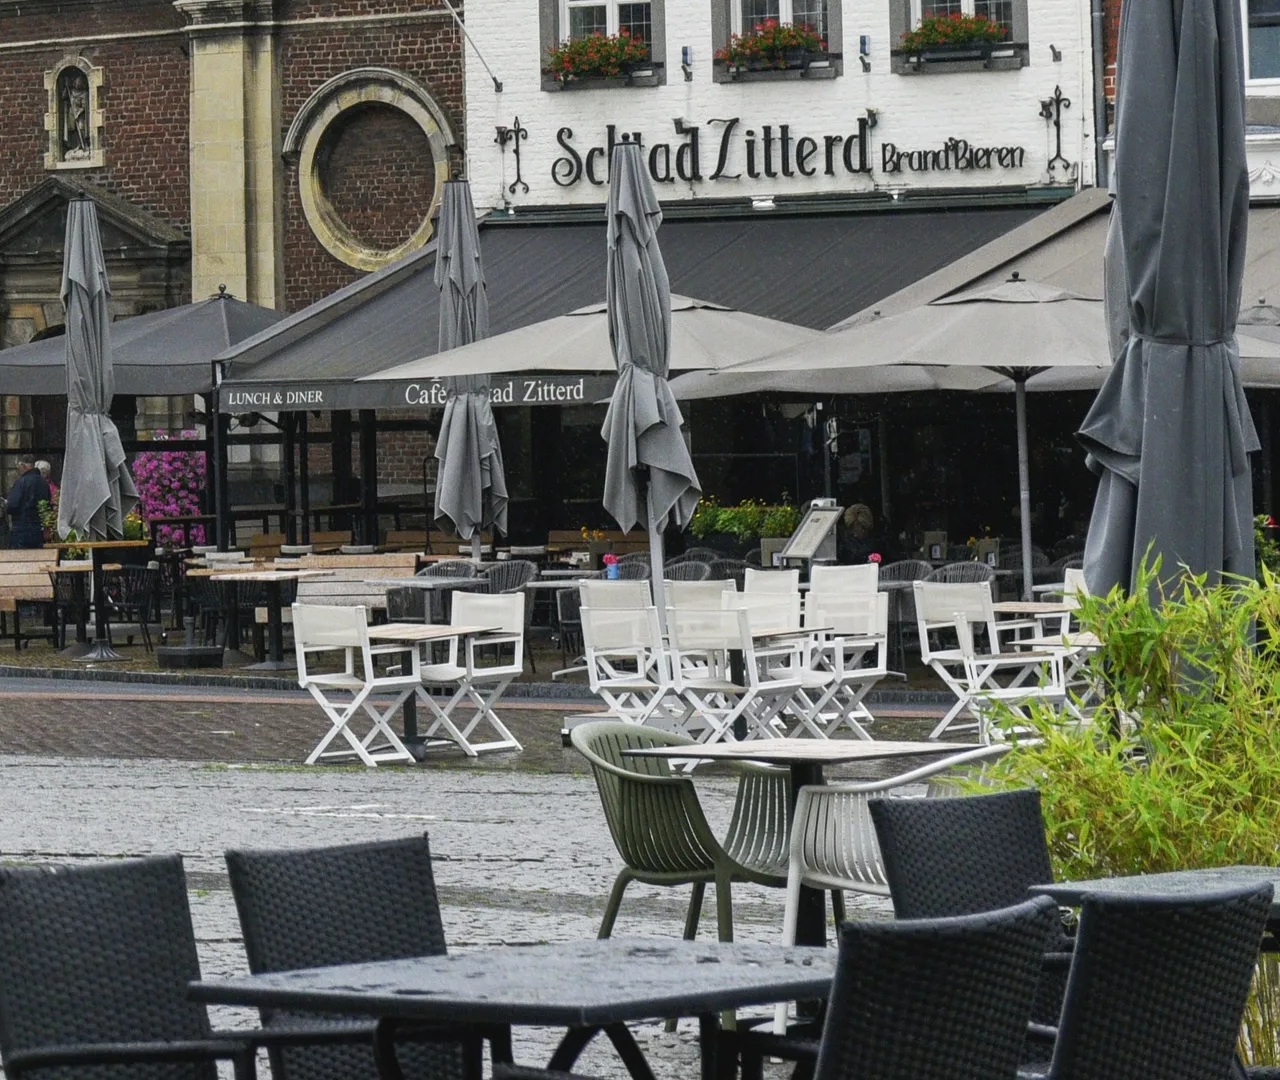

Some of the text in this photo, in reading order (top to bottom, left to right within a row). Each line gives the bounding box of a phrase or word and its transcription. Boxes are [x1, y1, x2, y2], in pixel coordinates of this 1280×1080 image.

[707, 117, 873, 180] Zitterd
[228, 390, 323, 405] LUNCH & DINER
[405, 381, 447, 405] Café
[523, 379, 584, 402] Zitterd
